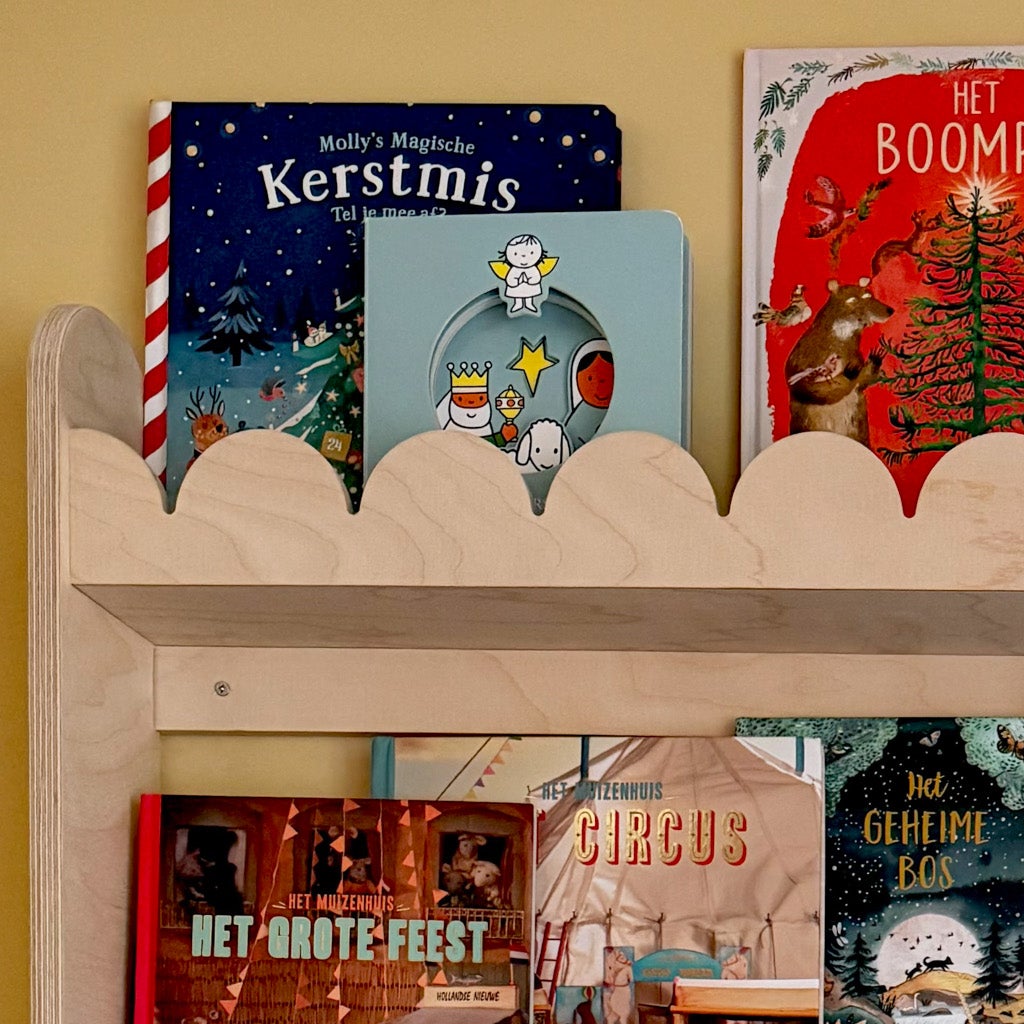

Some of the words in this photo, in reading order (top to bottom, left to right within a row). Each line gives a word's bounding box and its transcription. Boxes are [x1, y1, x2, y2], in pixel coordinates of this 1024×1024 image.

[953, 80, 1000, 115] HET
[319, 132, 384, 153] Molly's
[391, 131, 475, 155] Magische
[257, 154, 520, 212] Kerstmis
[330, 205, 357, 222] Tel
[327, 437, 343, 452] 24
[542, 782, 567, 800] HET
[906, 770, 949, 800] Het
[573, 808, 748, 866] CIRCUS
[863, 808, 990, 845] GEHEIME
[899, 854, 955, 891] BOS
[288, 893, 311, 909] HET
[316, 893, 394, 912] MUIZENHUIS
[191, 914, 254, 958] HET
[267, 916, 375, 961] GROTE
[388, 918, 489, 964] FEEST
[436, 991, 471, 1002] HOLLANDSE
[473, 991, 500, 1002] NIEUWE
